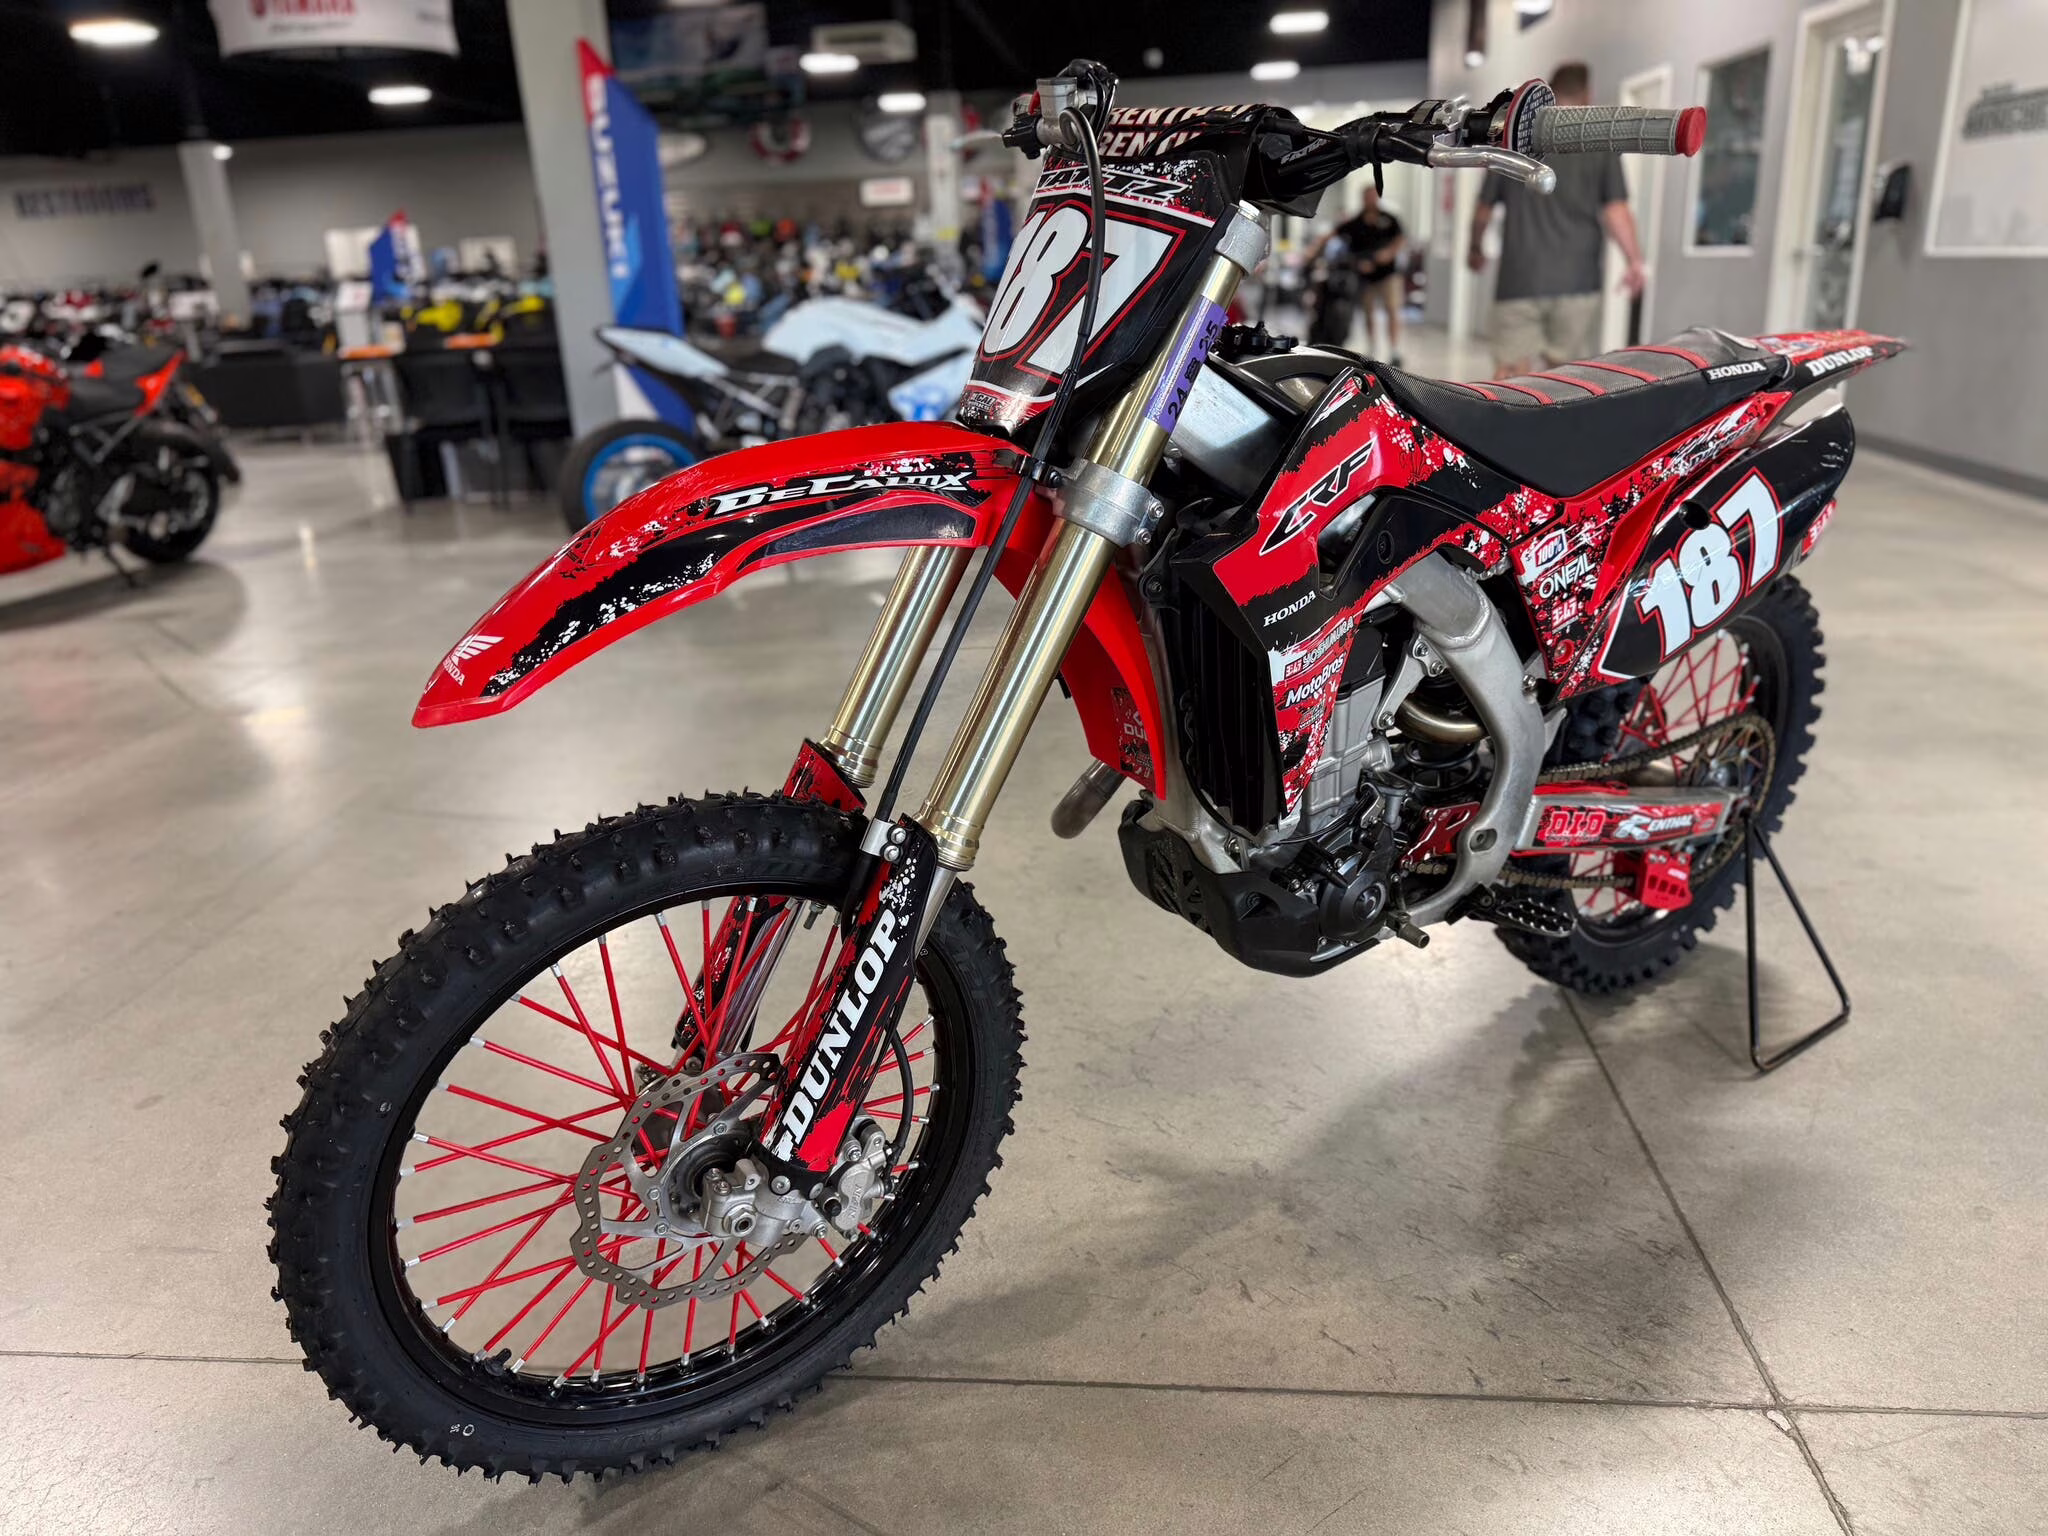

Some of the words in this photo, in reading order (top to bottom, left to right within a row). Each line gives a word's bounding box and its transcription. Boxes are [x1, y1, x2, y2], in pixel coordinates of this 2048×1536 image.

[1706, 361, 1767, 381] HONDA
[1804, 346, 1874, 377] DUNLOP
[1259, 435, 1378, 557] CRF
[1536, 533, 1563, 567] 100%
[1636, 468, 1784, 659] 187
[1263, 589, 1317, 627] HONDA
[782, 908, 898, 1145] DUNLOP
